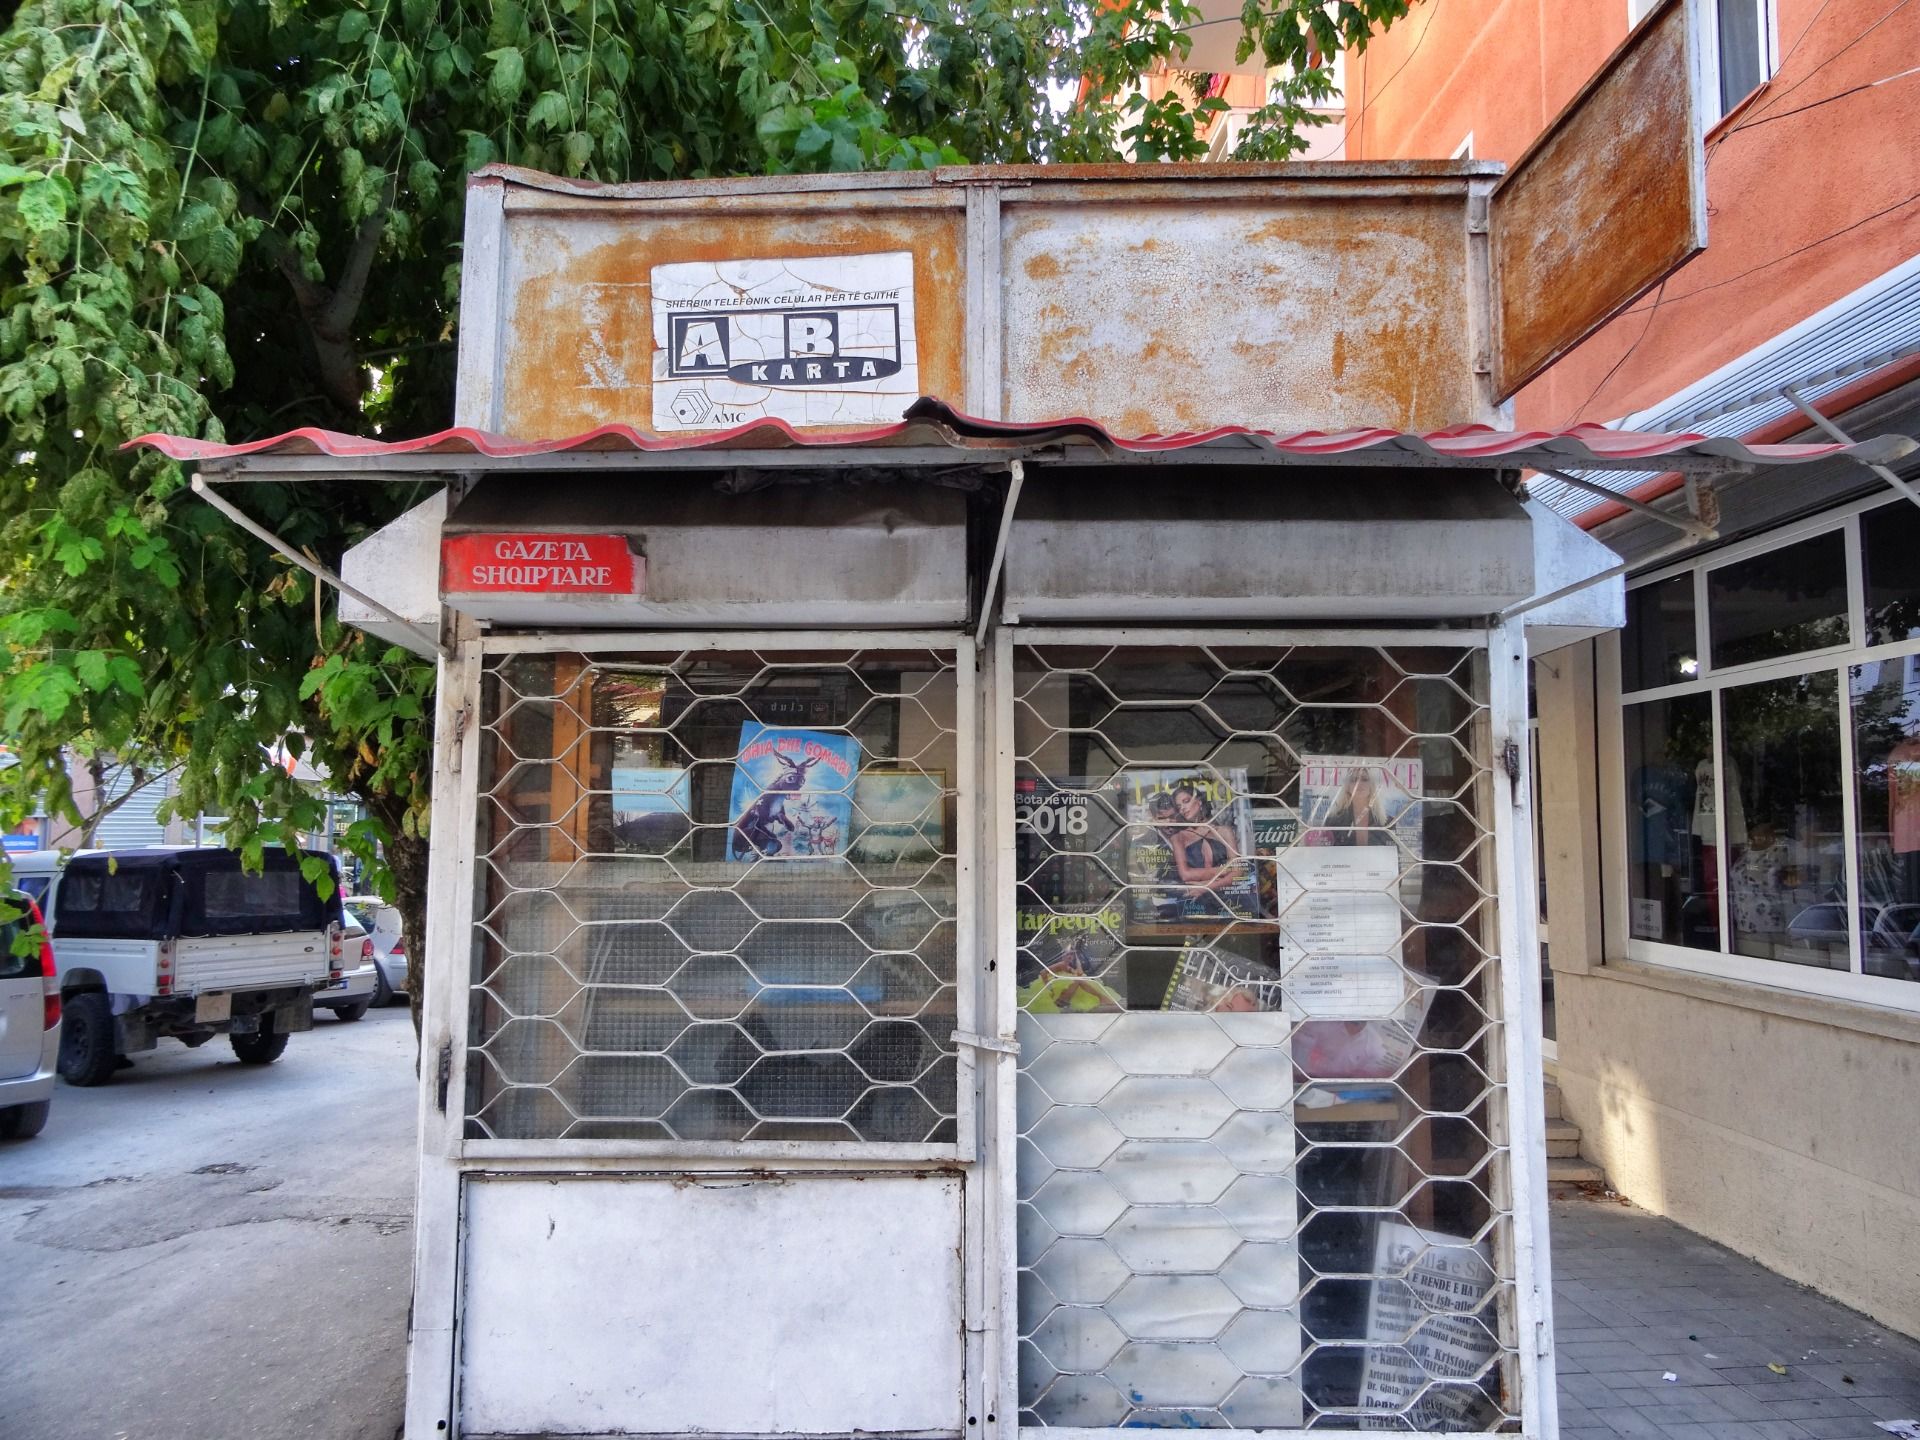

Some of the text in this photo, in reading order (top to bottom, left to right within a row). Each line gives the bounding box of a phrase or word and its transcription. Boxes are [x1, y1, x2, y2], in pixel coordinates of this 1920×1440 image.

[714, 296, 770, 307] TELEFONIK
[774, 294, 822, 304] CELULAR
[751, 360, 877, 381] KARTA
[712, 411, 746, 424] AMC
[495, 540, 592, 561] GAZETA
[472, 565, 612, 586] SHQIPTARE
[1061, 793, 1088, 805] vitin
[1016, 805, 1089, 836] 2018
[1421, 1274, 1452, 1292] RENDE
